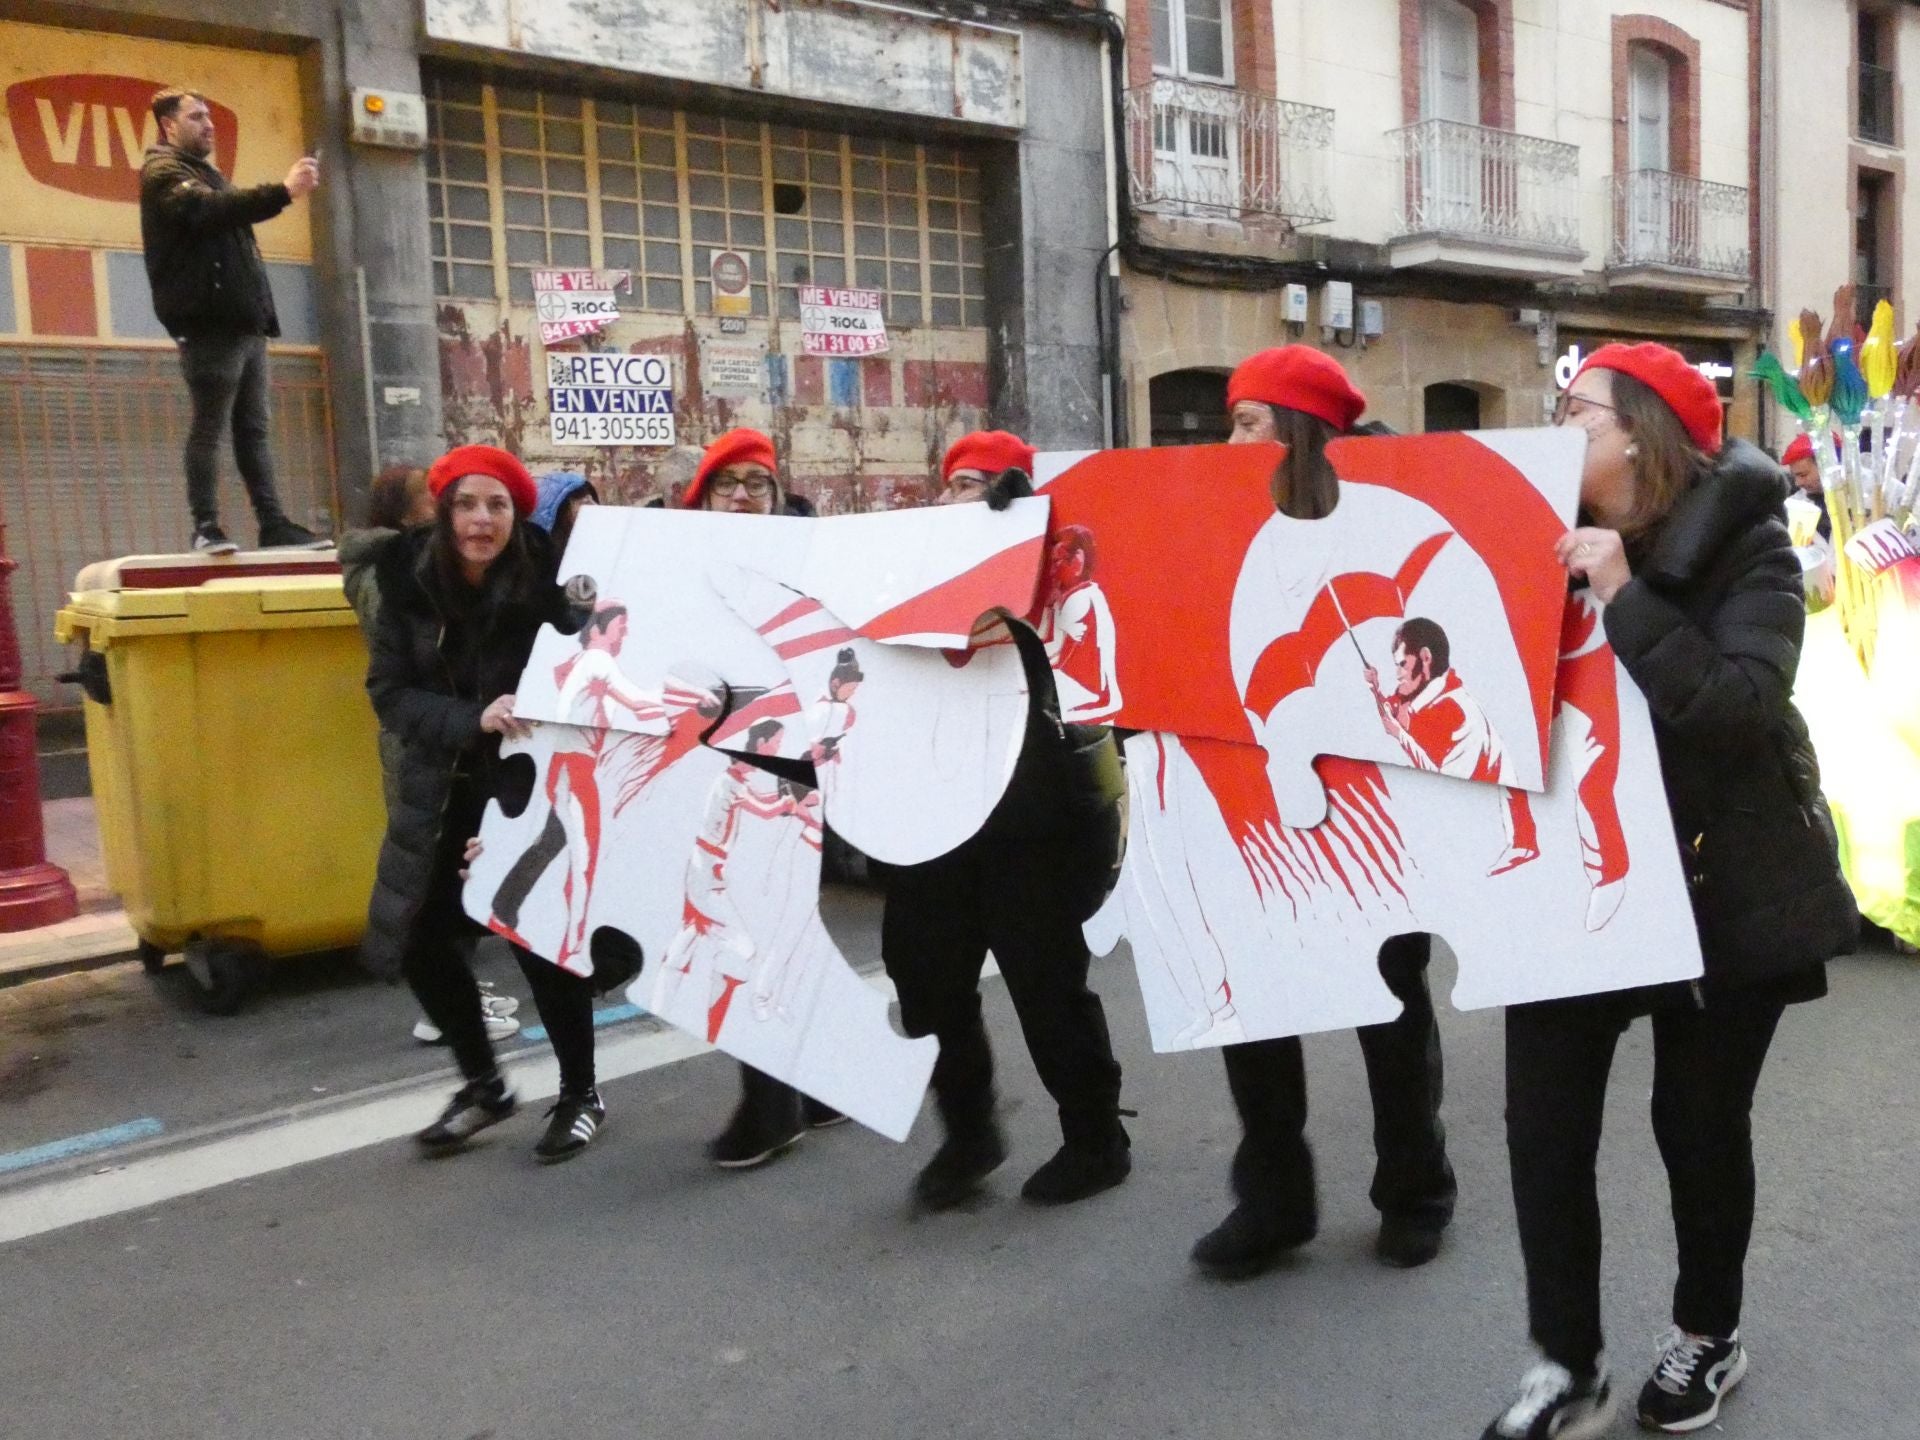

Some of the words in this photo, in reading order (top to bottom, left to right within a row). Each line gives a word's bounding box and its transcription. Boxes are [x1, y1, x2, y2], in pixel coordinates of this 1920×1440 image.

[34, 97, 217, 171] VIV
[536, 271, 563, 290] ME
[802, 288, 825, 305] ME
[828, 289, 878, 309] VENDE
[542, 321, 571, 339] 941
[575, 320, 594, 334] 31
[804, 333, 826, 350] 941
[830, 335, 844, 351] 31
[848, 336, 864, 352] 00
[570, 356, 665, 385] REYCO
[553, 389, 585, 412] EN
[590, 390, 669, 413] VENTA
